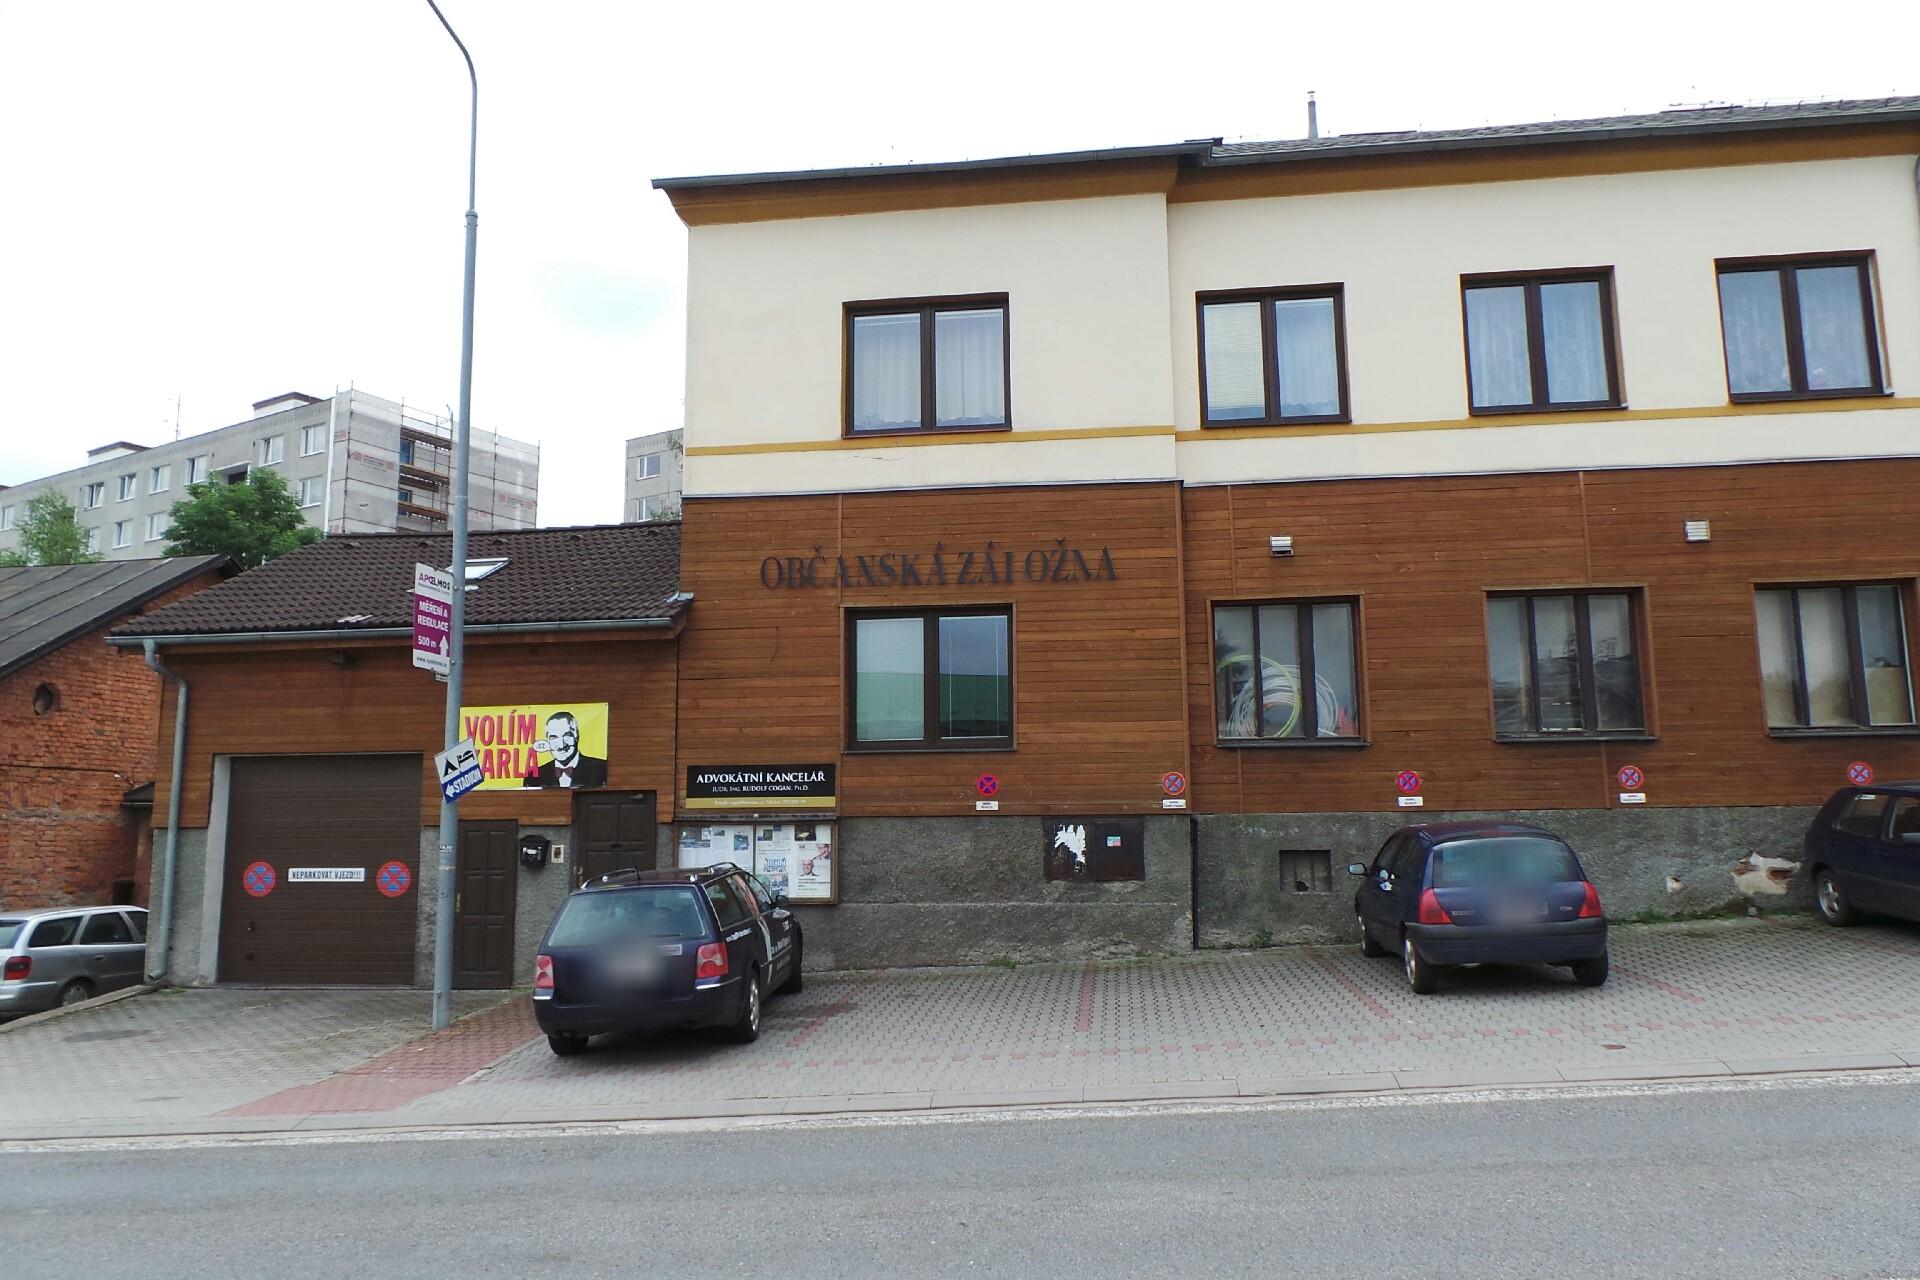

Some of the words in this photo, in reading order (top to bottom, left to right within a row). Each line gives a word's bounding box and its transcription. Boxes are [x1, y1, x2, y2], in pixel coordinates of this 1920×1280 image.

[760, 541, 947, 589] OBČANSKÁ
[419, 600, 443, 617] MĚŘENÍ
[443, 609, 448, 618] A
[417, 614, 449, 632] REGULACE
[418, 635, 430, 647] 500
[431, 640, 437, 648] m
[465, 709, 537, 746] VOLÍM
[476, 747, 539, 779] ARLA
[453, 767, 482, 793] STADION
[696, 772, 763, 784] ADVOKÁTNÍ
[766, 770, 826, 783] KANCELÁŘ
[292, 871, 332, 879] NEPARKOVAT
